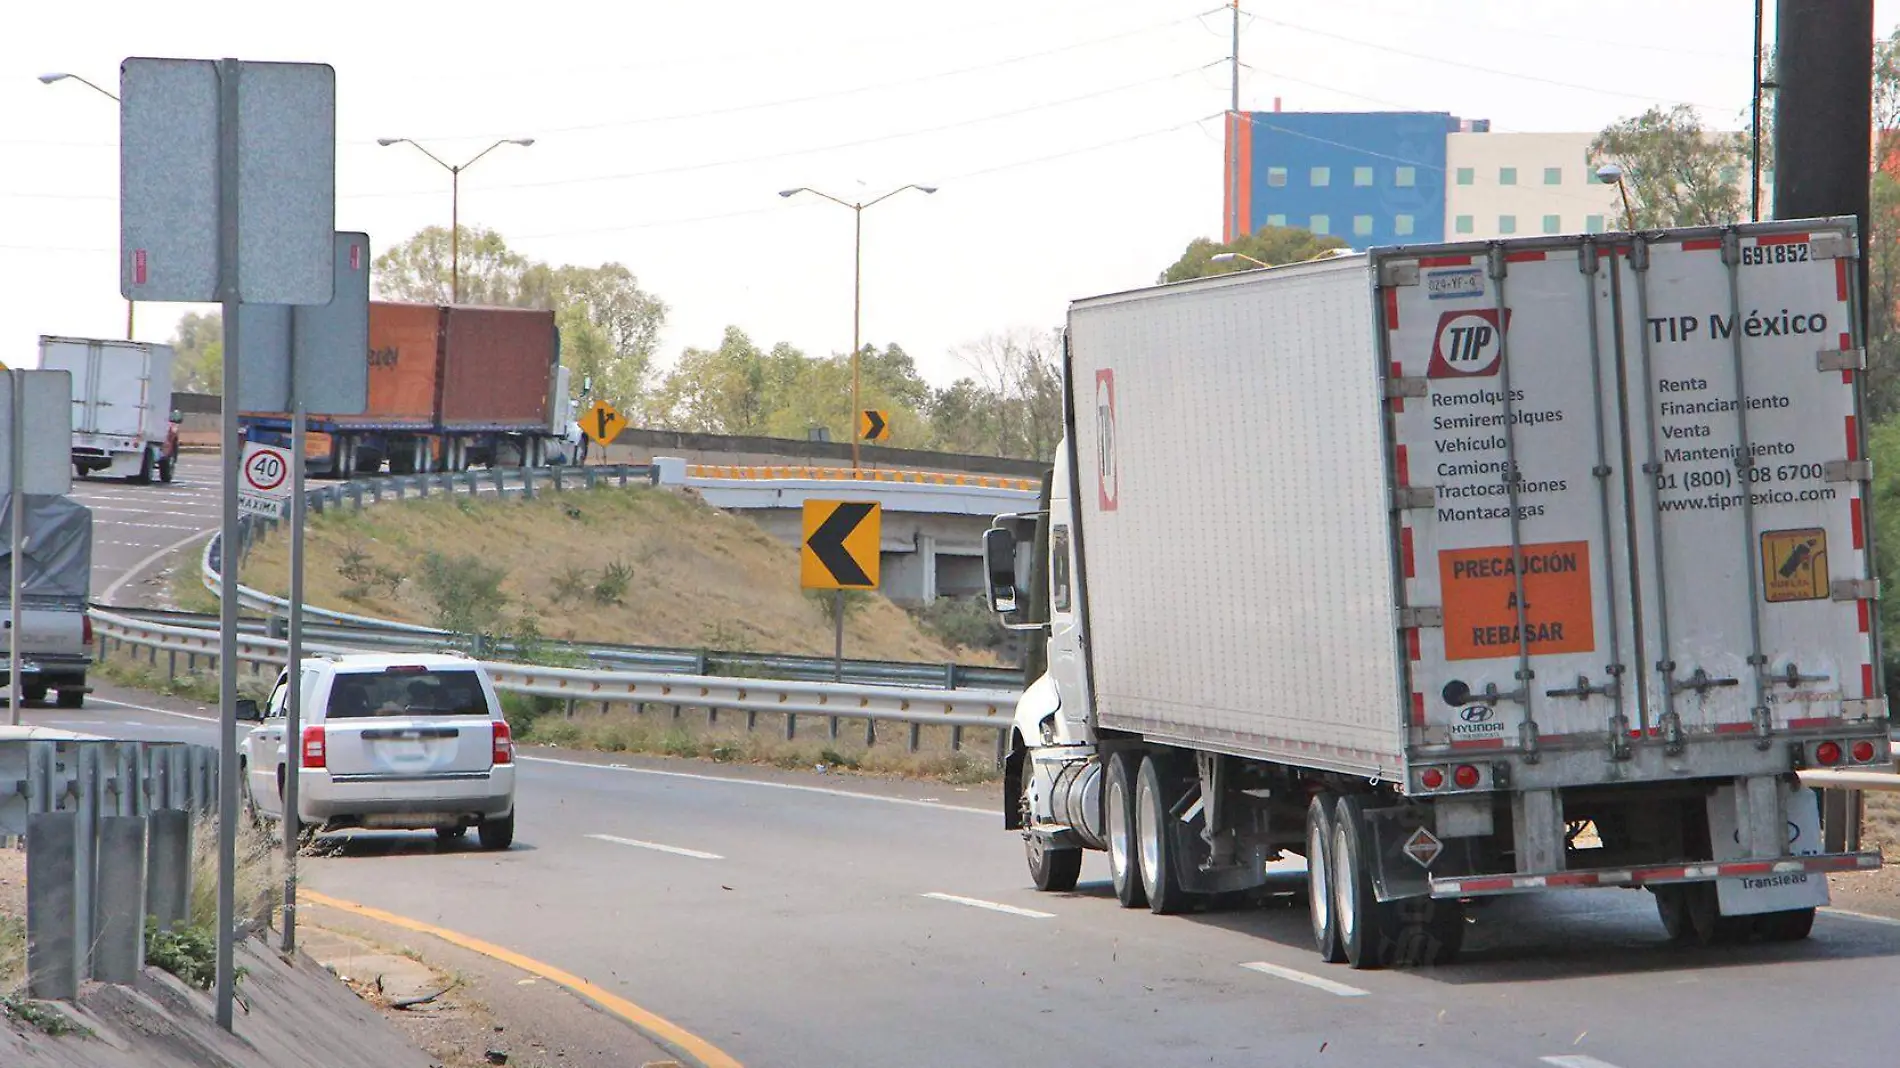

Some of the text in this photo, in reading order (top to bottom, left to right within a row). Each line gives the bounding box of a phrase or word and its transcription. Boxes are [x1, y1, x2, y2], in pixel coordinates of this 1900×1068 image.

[1742, 243, 1808, 266] 691852
[1648, 308, 1828, 343] TIP México
[1450, 326, 1492, 362] TIP
[1659, 378, 1708, 393] Renta
[1431, 389, 1524, 407] Remolques
[1660, 395, 1790, 416] Financiamiento
[1433, 409, 1563, 430] Semiremolques
[1662, 424, 1711, 439] Venta
[254, 457, 279, 477] 40
[1656, 473, 1678, 490] 01
[1684, 469, 1732, 491] (800)
[1777, 463, 1823, 481] 6700
[1657, 487, 1837, 512] www.tipmexico.com
[1438, 504, 1545, 523] Montacagas
[1453, 550, 1577, 580] PRECAUCIÓN
[1472, 622, 1564, 646] REBASAR
[1452, 722, 1504, 734] HYUNDAI
